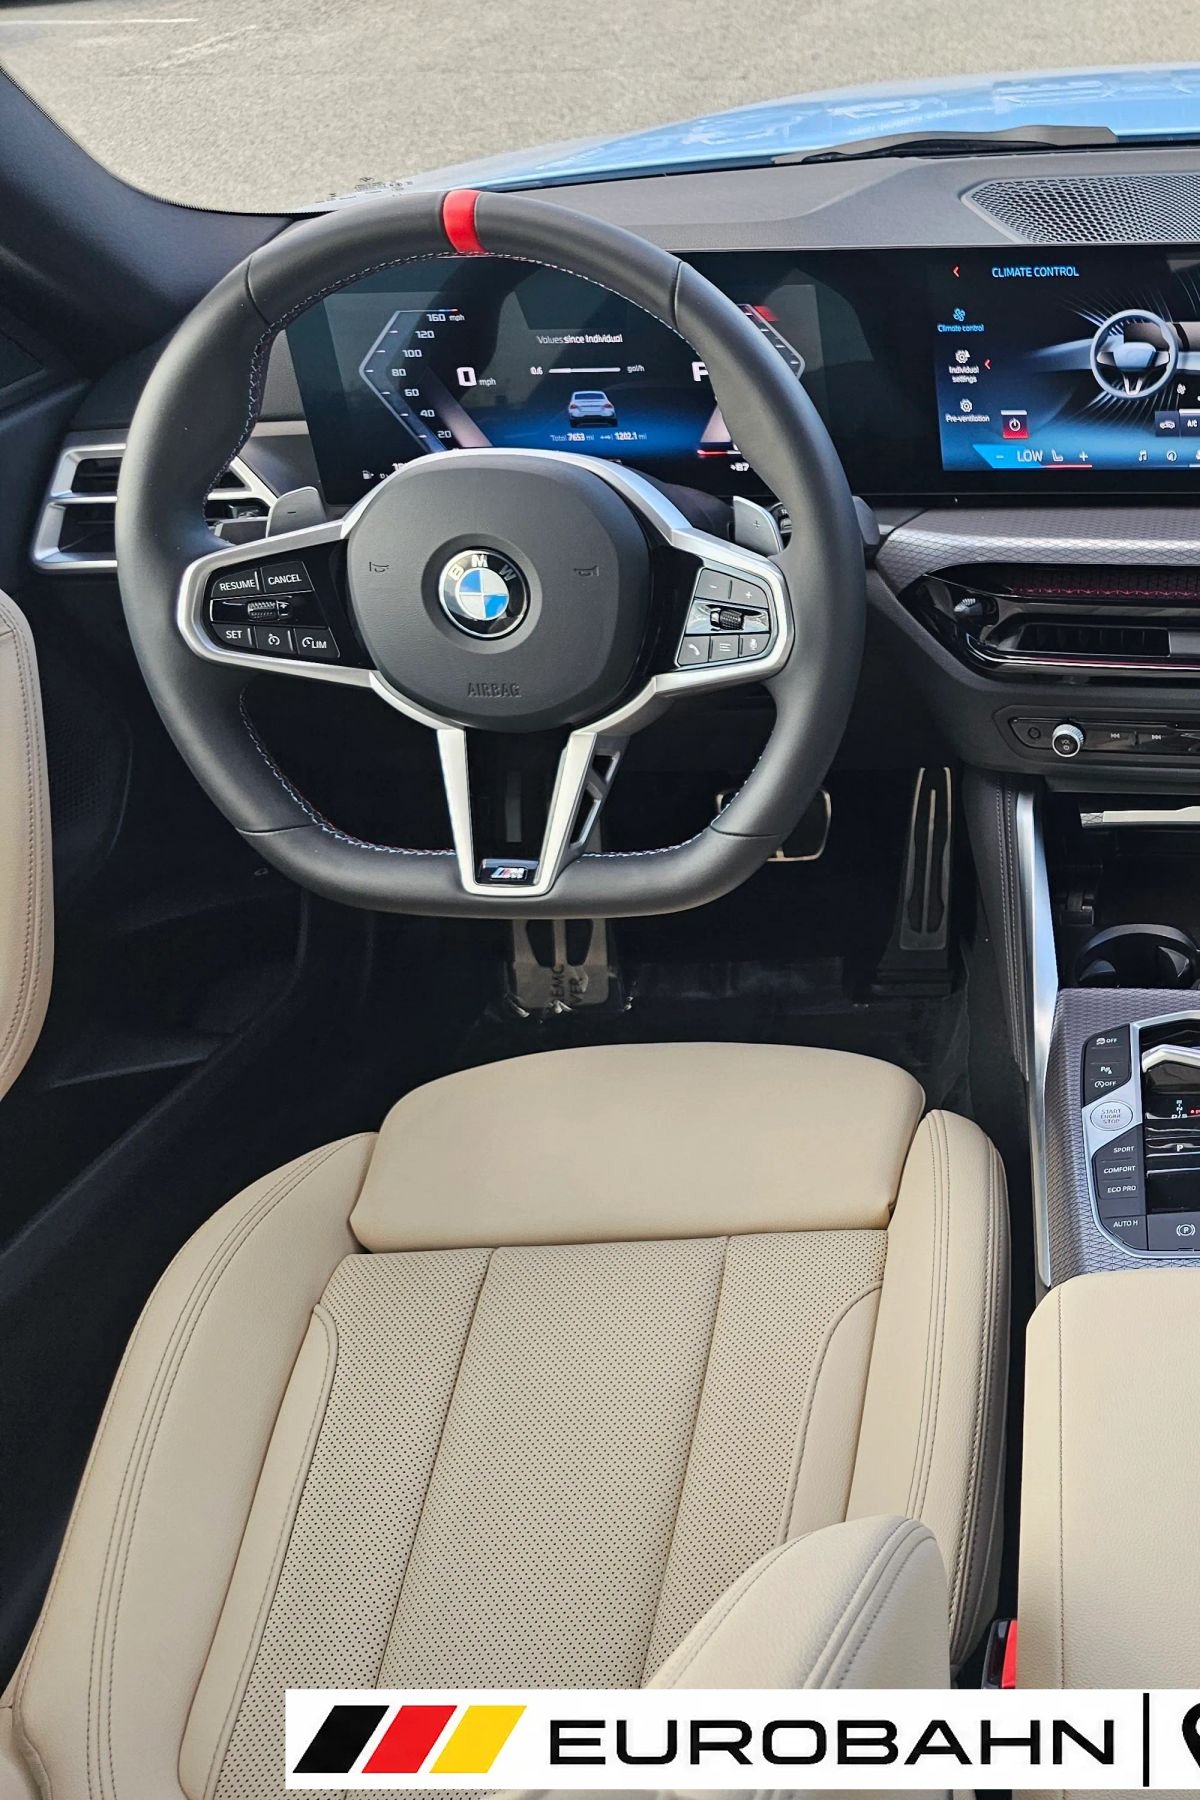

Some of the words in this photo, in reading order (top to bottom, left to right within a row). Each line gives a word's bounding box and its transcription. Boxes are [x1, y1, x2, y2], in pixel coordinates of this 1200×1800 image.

[991, 266, 1033, 278] CLIMATE
[1033, 265, 1080, 278] CONTROL
[426, 313, 446, 322] 160
[448, 314, 465, 322] mph
[937, 323, 961, 333] Climate
[961, 323, 984, 333] control
[415, 330, 435, 339] 120
[536, 335, 563, 345] Values
[563, 334, 584, 344] since
[402, 349, 422, 358] 100
[391, 368, 407, 377] 80
[948, 365, 979, 375] Individual
[456, 366, 477, 387] 0
[478, 377, 497, 387] mph
[404, 388, 420, 397] 60
[419, 409, 436, 418] 40
[437, 430, 452, 439] 20
[1016, 450, 1044, 462] LOW
[447, 554, 518, 582] BMW
[268, 573, 303, 586] CANCEL
[219, 579, 256, 592] RESUME
[225, 630, 243, 639] SET
[311, 639, 327, 649] LIM
[467, 682, 523, 698] AIRBAG
[1113, 1146, 1135, 1154] SPORT
[1176, 1144, 1184, 1152] P
[1103, 1165, 1136, 1174] COMFORT
[1113, 1220, 1133, 1228] AUTO
